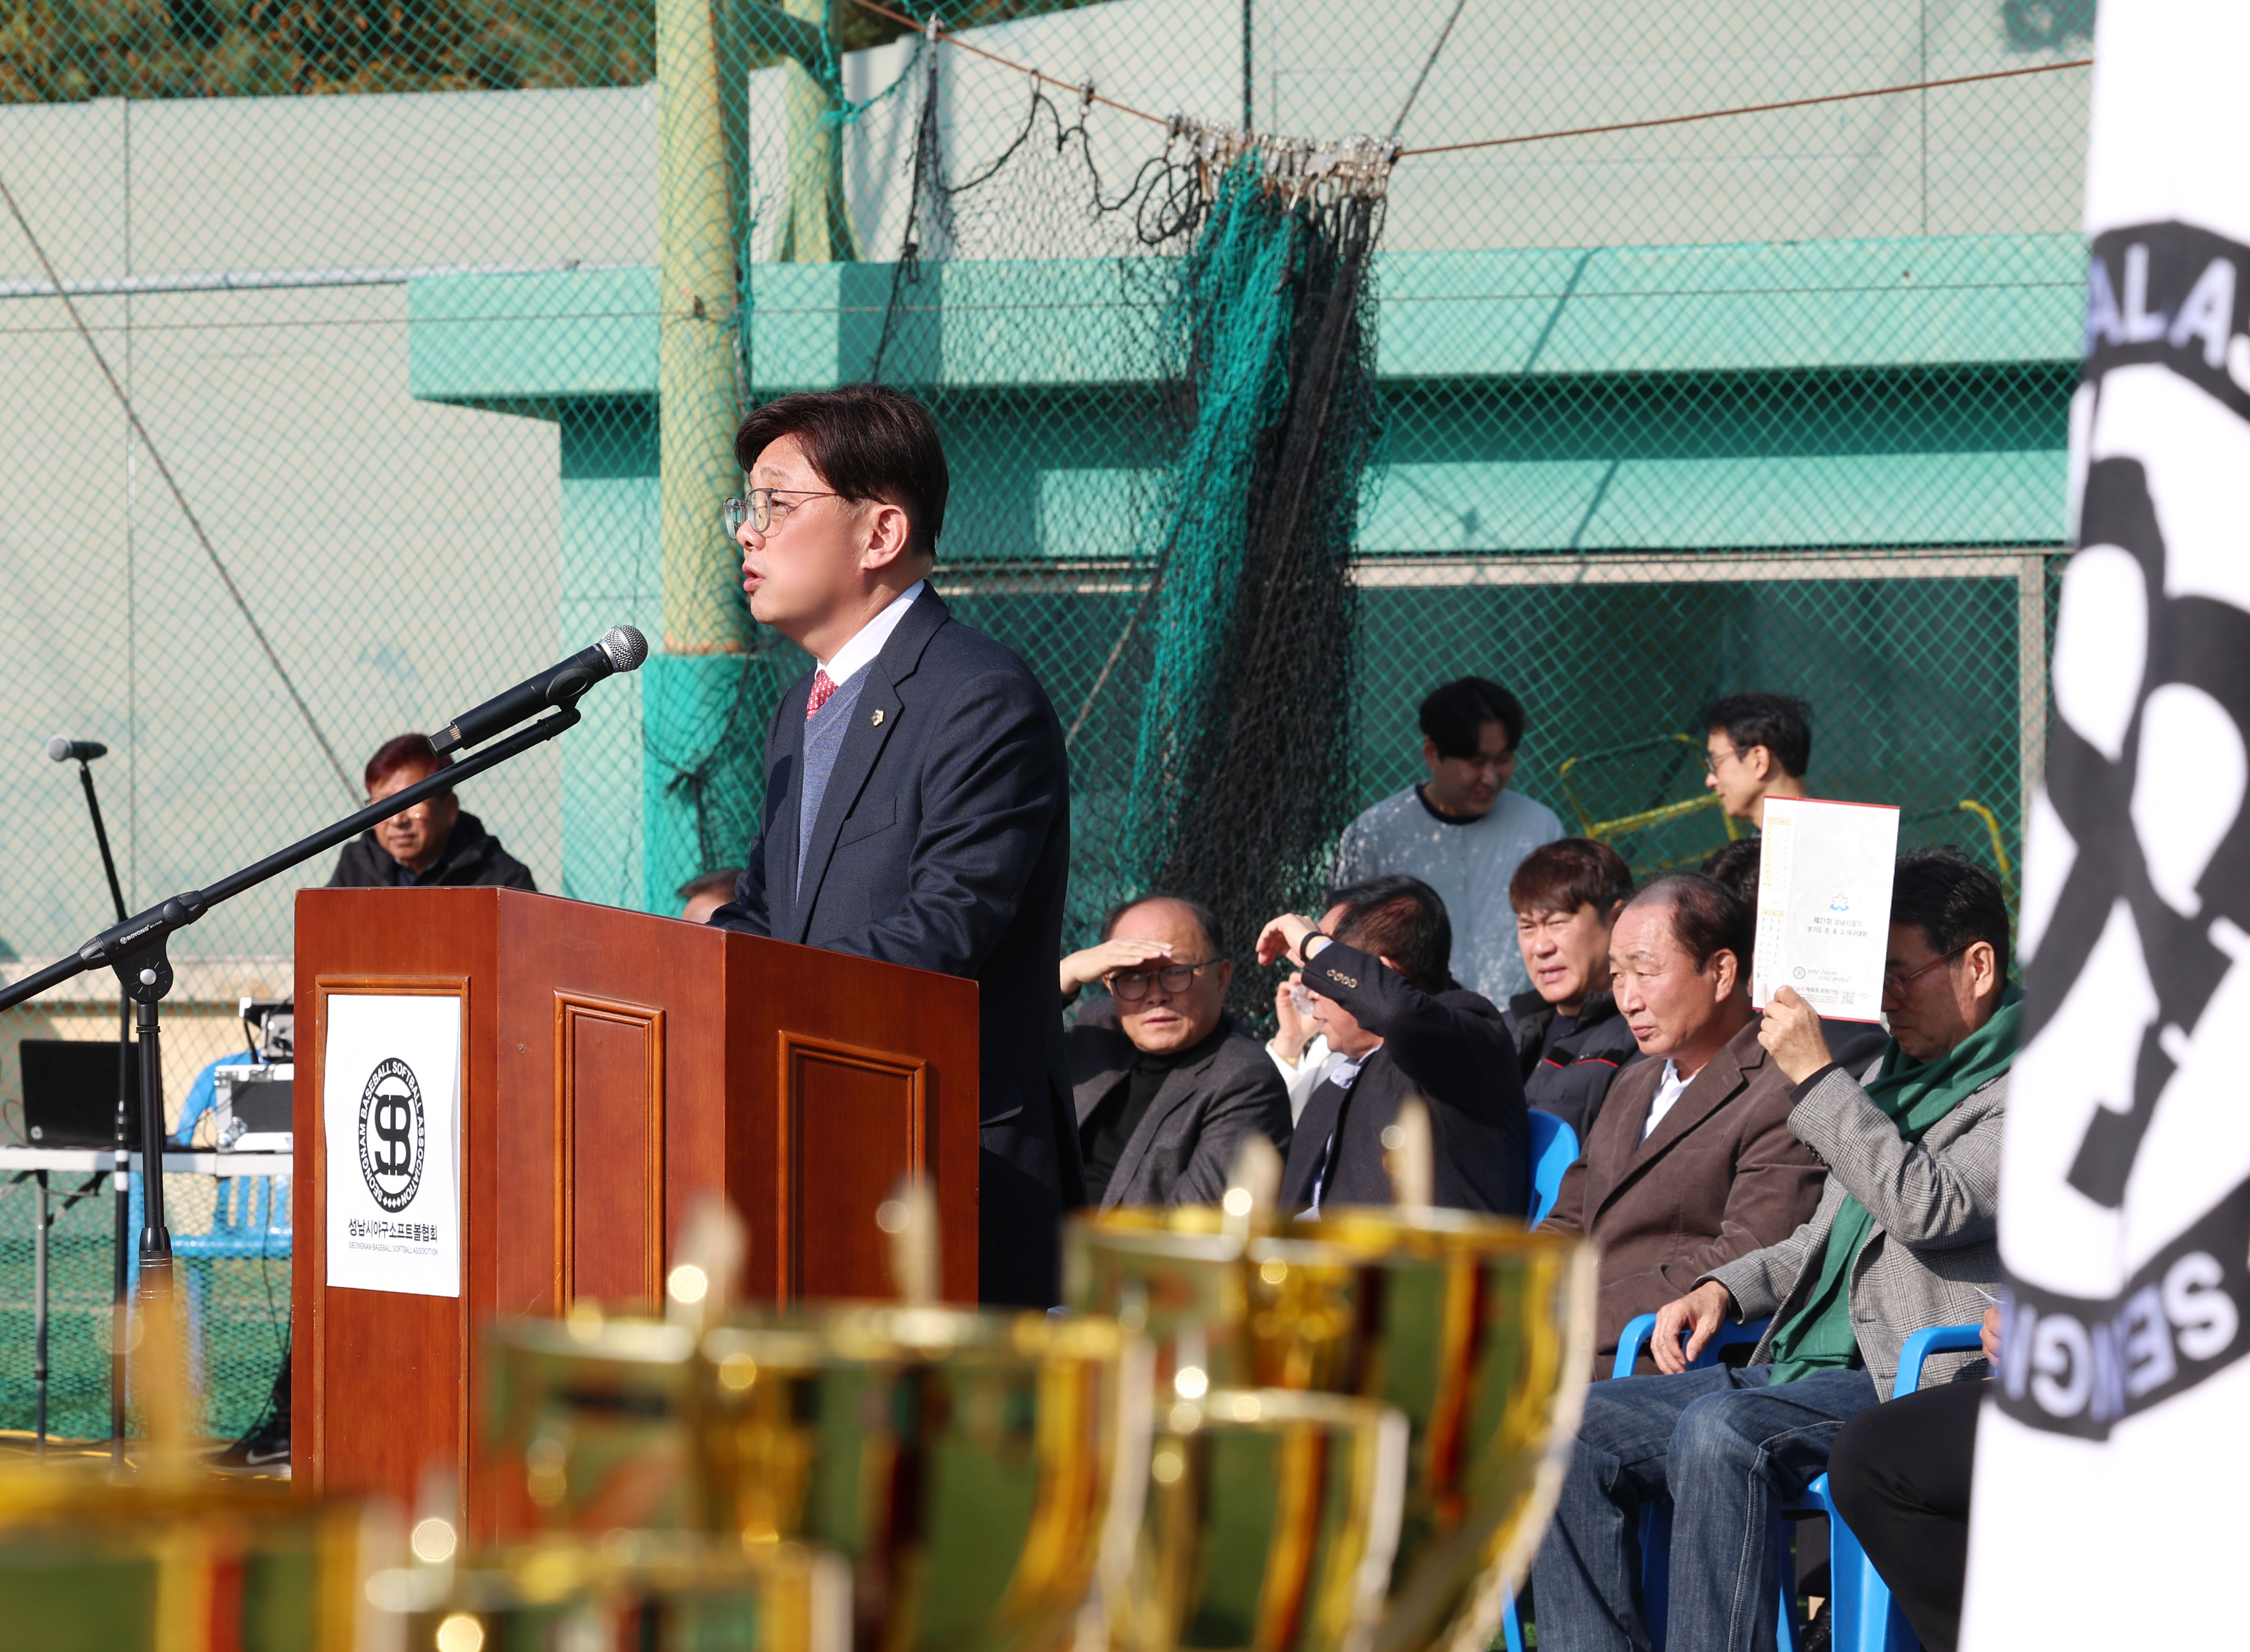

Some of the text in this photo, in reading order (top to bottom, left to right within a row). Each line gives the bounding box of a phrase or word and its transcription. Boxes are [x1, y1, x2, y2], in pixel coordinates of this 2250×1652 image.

[126, 926, 149, 940] BOYONG
[359, 1061, 424, 1206] SEONGNAM BASEBALL SOFTBALL ASSOCIATION
[349, 1218, 437, 1243] 성남시야구소프트볼협회
[349, 1241, 372, 1250] SEONGNAM
[373, 1243, 392, 1252] BASEBALL
[393, 1245, 412, 1254] SOFTBALL
